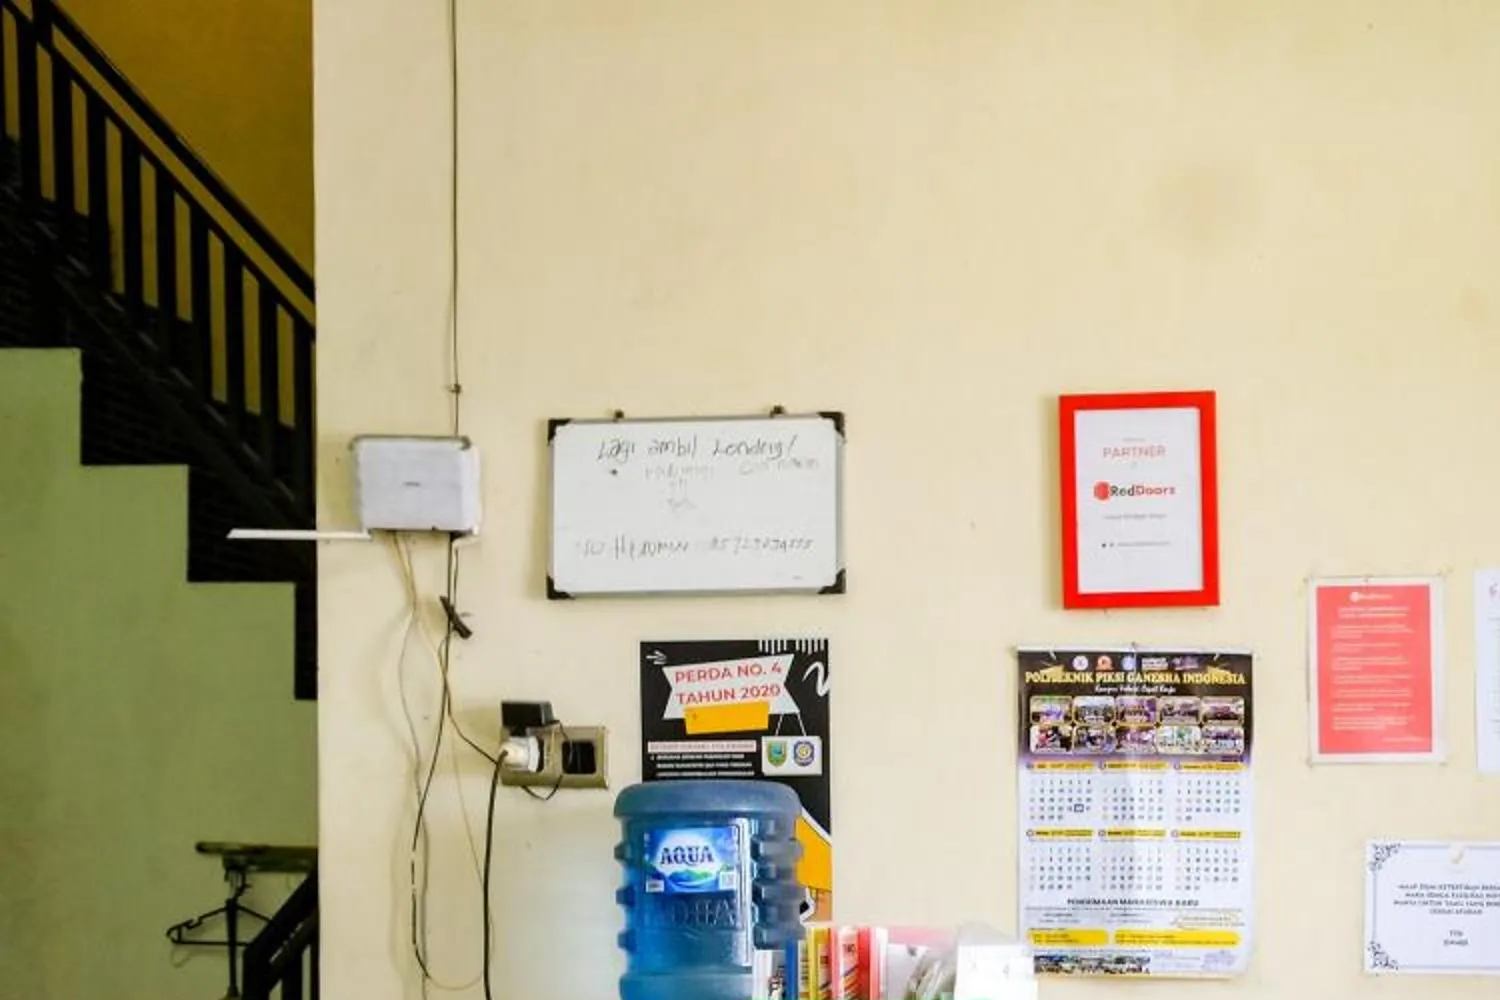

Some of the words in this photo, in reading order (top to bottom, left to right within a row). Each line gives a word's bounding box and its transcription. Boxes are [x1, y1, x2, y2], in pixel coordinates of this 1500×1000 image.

[1102, 444, 1167, 459] PARTNER
[675, 667, 733, 685] PERDA
[737, 663, 767, 678] NO.
[771, 661, 783, 675] 4
[676, 688, 736, 706] TAHUN
[739, 684, 781, 700] 2020
[660, 845, 715, 866] AQUA
